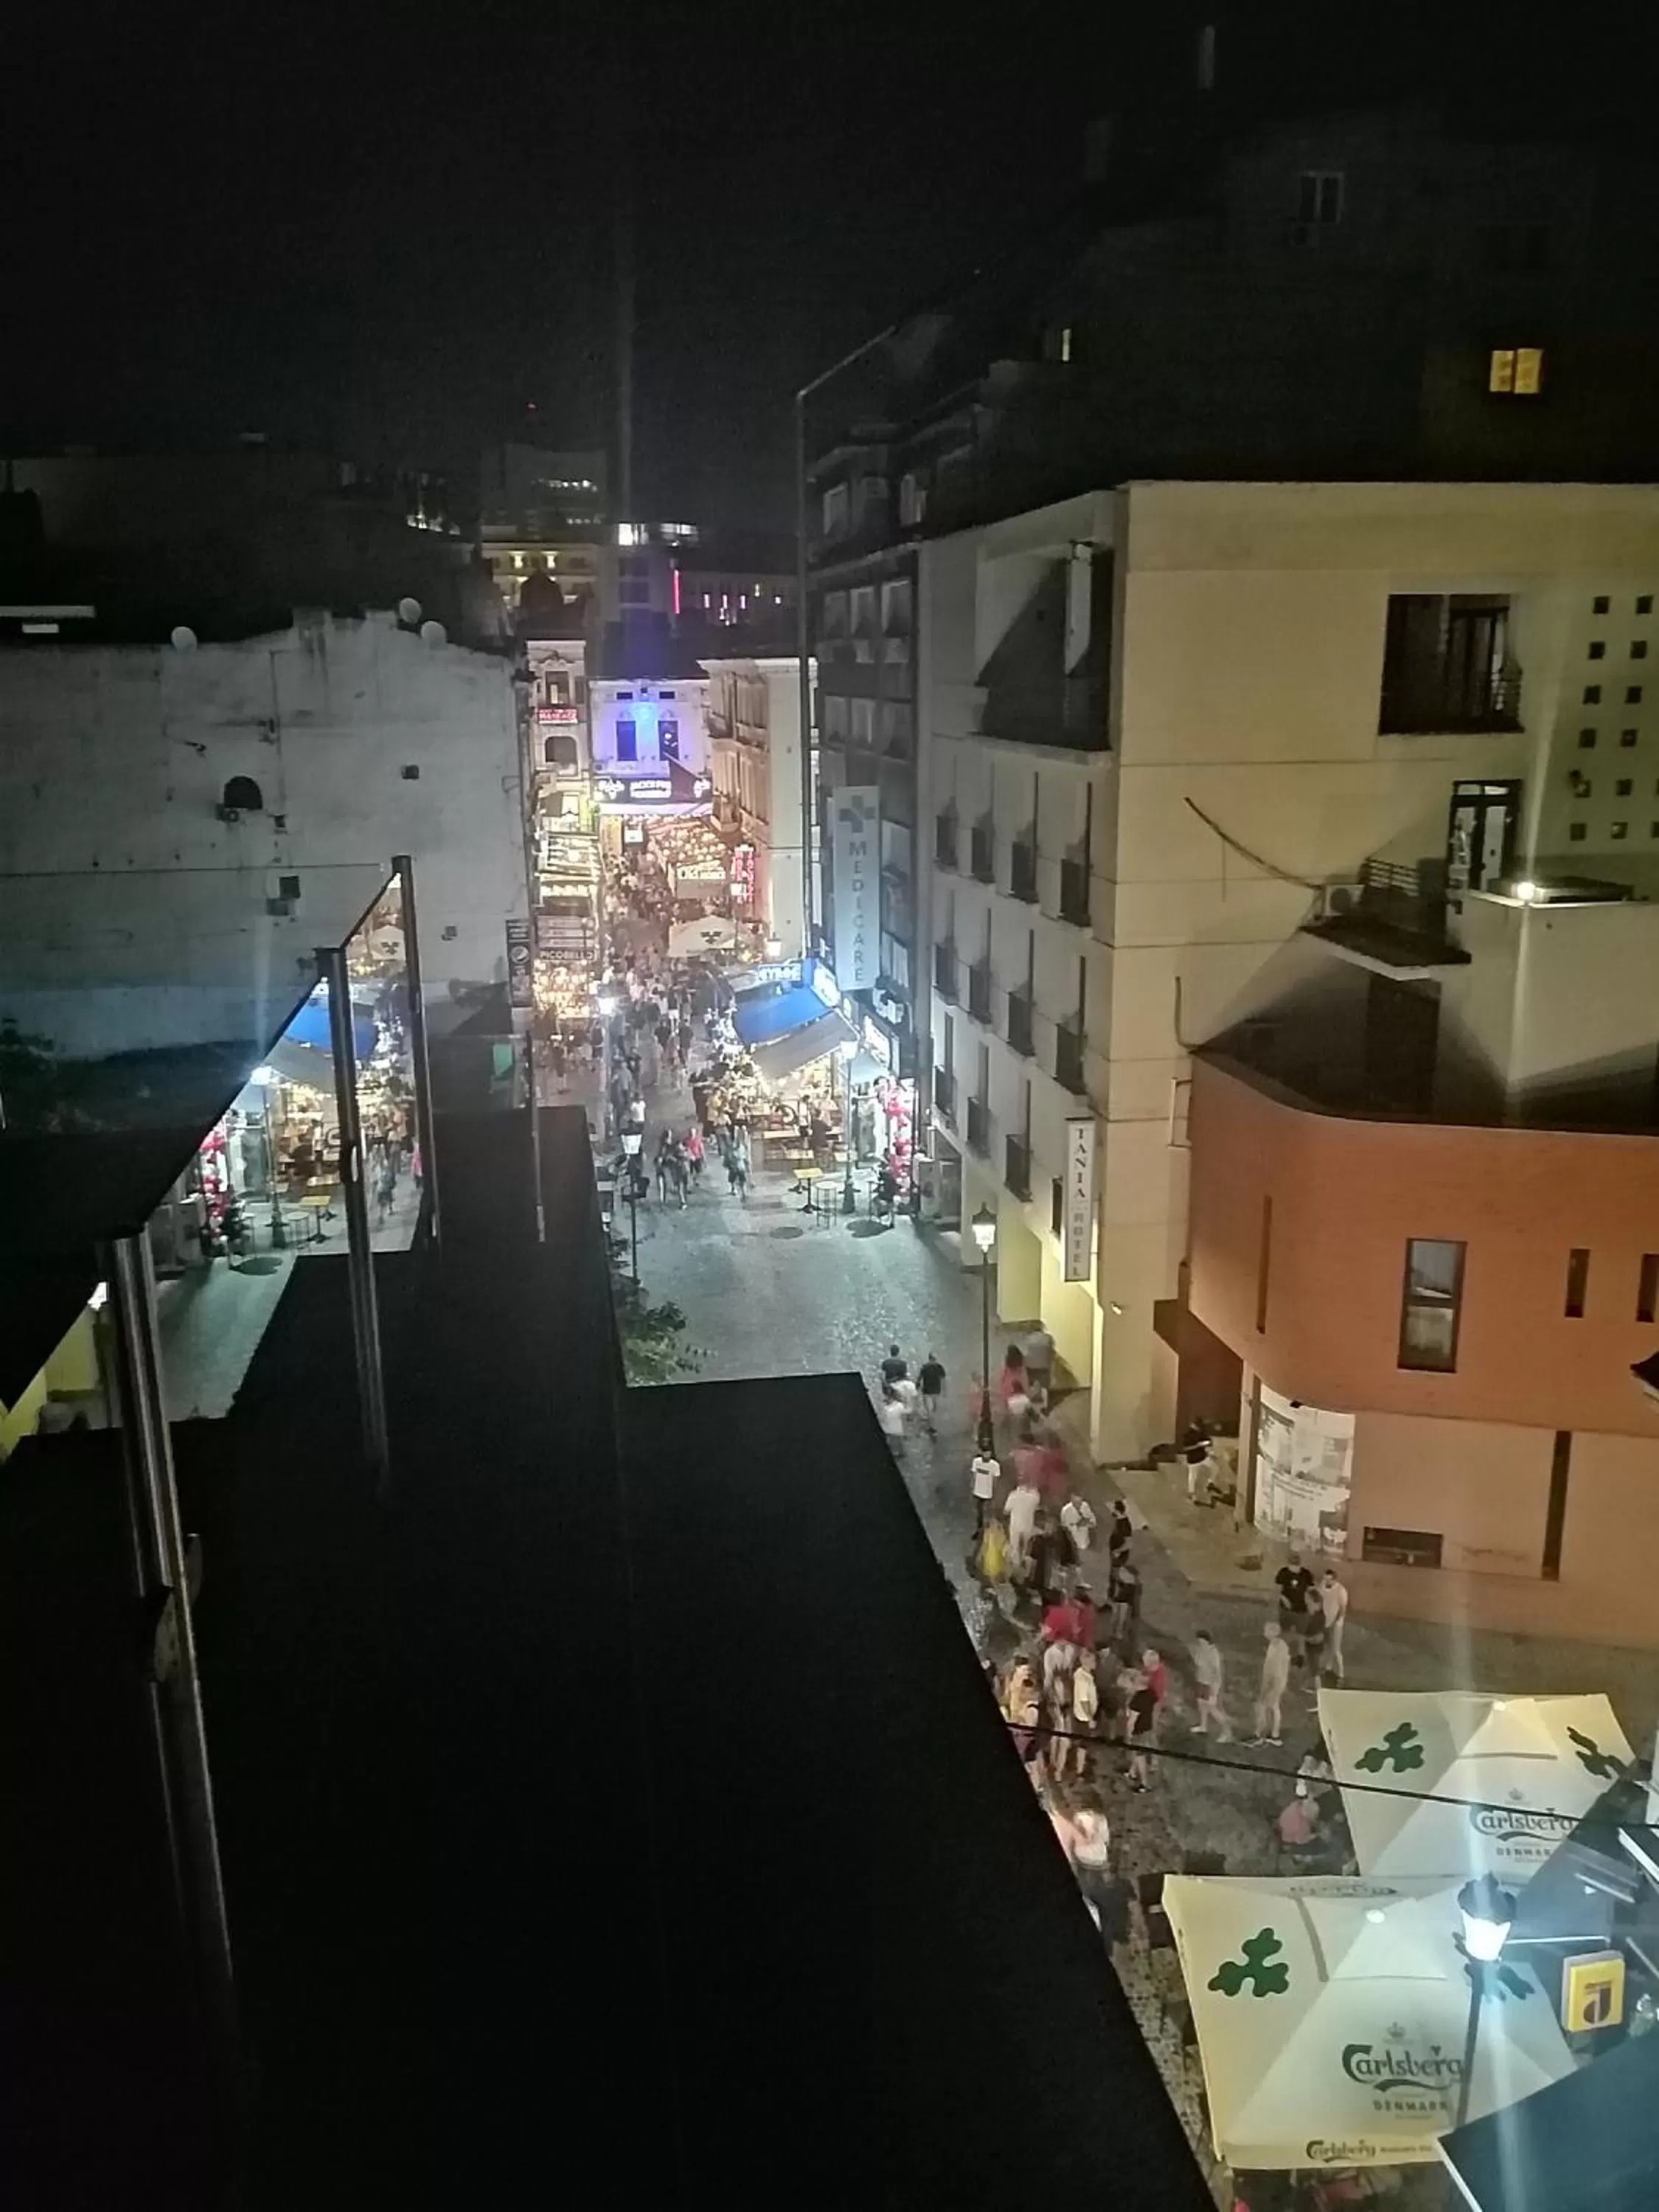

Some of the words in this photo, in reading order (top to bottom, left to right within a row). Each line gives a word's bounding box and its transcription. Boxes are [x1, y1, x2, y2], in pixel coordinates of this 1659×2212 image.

[849, 841, 867, 981] MEDICARE
[1074, 1127, 1087, 1202] TANIA
[1073, 1212, 1085, 1277] HOTEL
[1342, 2044, 1464, 2090] Carlsberg
[1373, 2099, 1450, 2112] DENMARK
